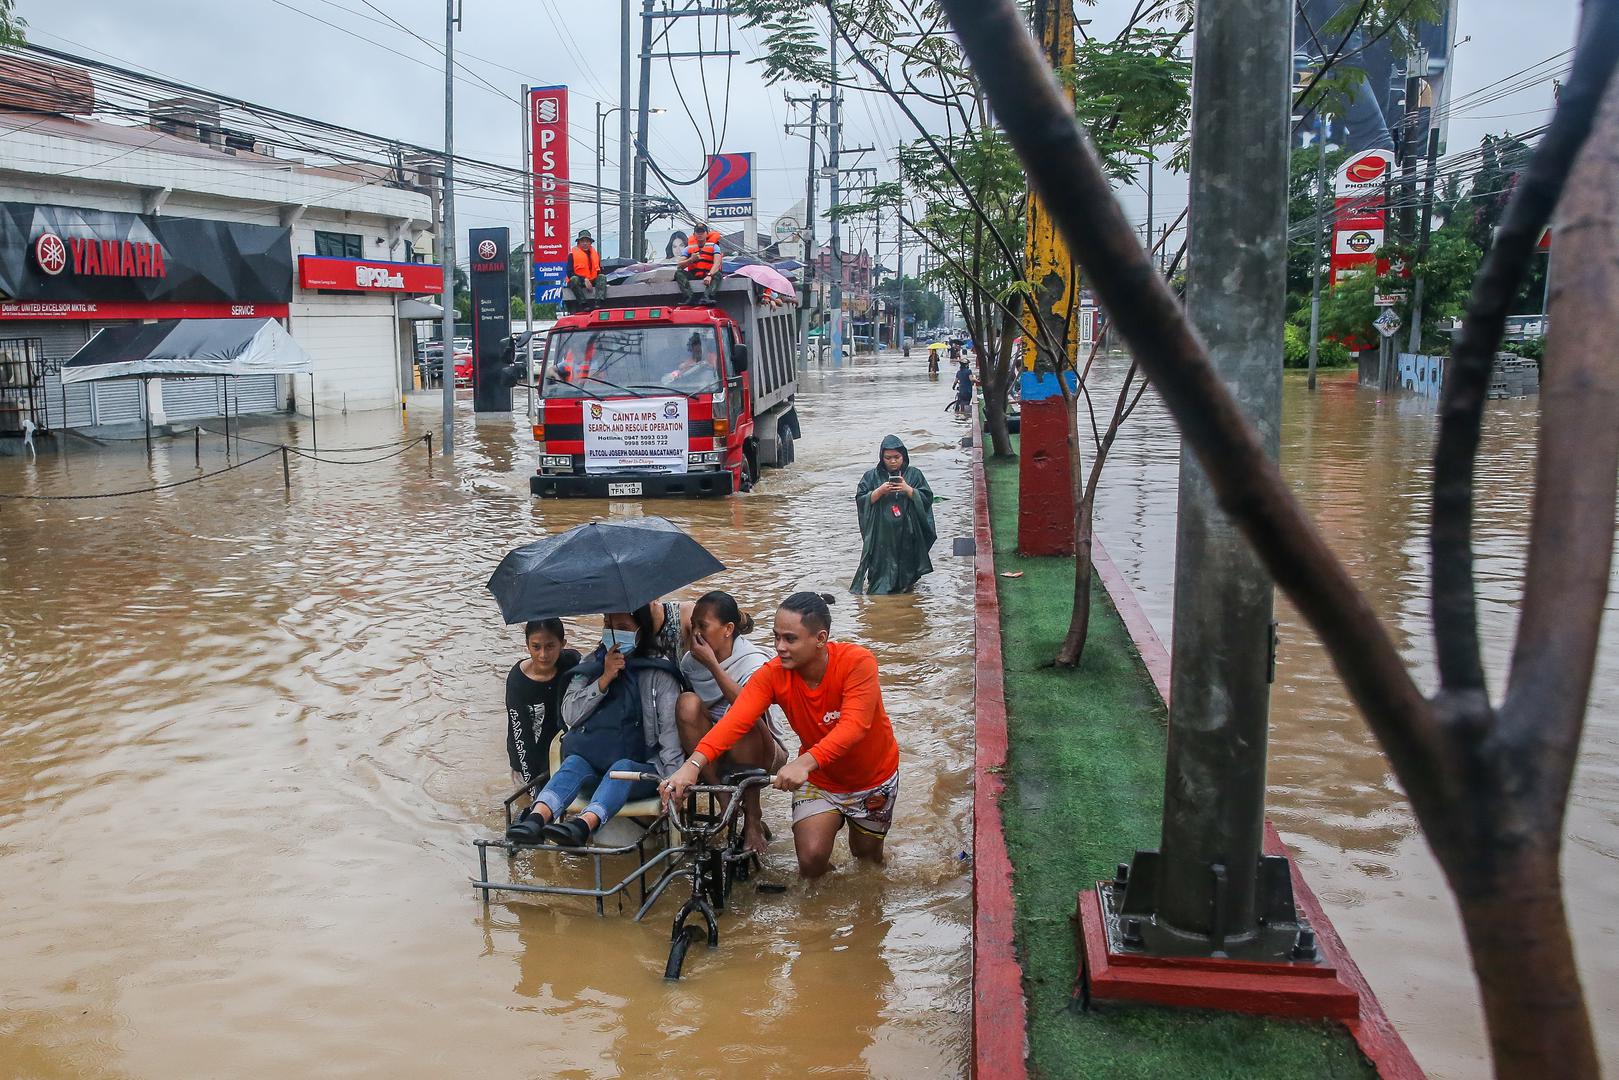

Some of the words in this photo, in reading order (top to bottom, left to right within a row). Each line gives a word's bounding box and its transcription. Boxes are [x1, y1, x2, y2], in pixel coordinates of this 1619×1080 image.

[540, 129, 556, 237] PSBank
[708, 206, 752, 216] PETRON
[68, 236, 166, 278] YAMAHA
[473, 264, 505, 272] YAMAHA
[367, 267, 405, 289] PSBank
[541, 287, 562, 301] ATM
[21, 303, 41, 312] UNITED
[41, 303, 71, 312] EXCELSIOR
[87, 303, 98, 312] INC.
[231, 305, 255, 316] SERVICE
[612, 413, 640, 422] CAINTA
[641, 412, 657, 421] MPS
[588, 423, 611, 433] SEARCH
[611, 423, 624, 432] AND
[625, 423, 648, 432] RESCUE
[649, 422, 683, 431] OPERATION
[608, 449, 628, 457] JOSEPH
[649, 448, 684, 457] MACATANGAY
